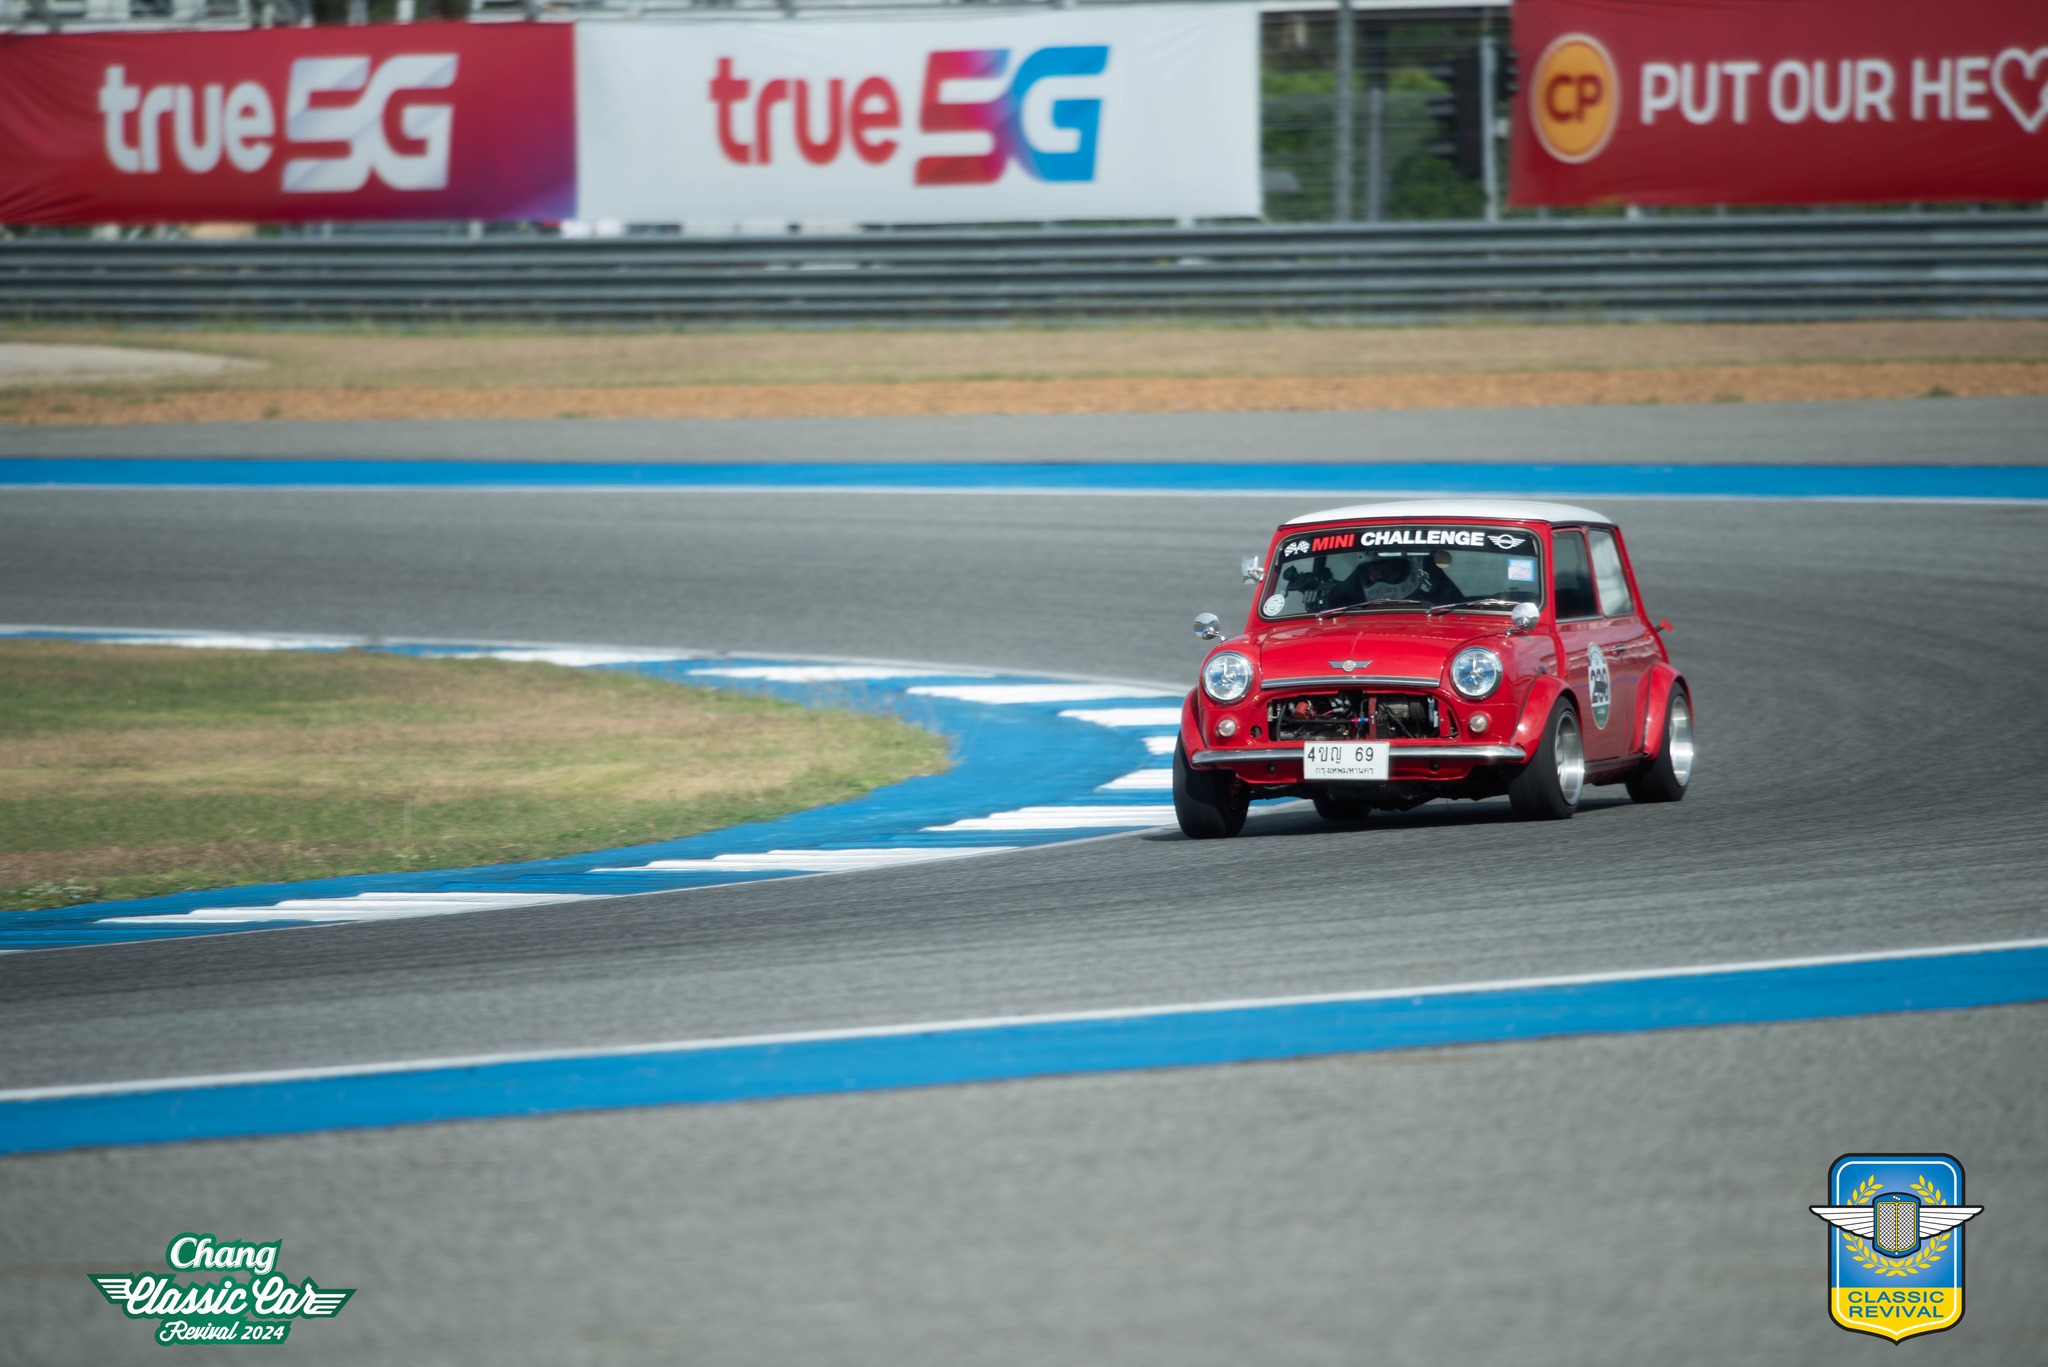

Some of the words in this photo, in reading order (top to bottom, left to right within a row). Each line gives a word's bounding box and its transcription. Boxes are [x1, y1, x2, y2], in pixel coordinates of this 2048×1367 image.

[708, 57, 901, 165] true
[913, 45, 1109, 186] 5G
[1545, 74, 1601, 124] CP
[1641, 61, 1760, 125] PUT
[1769, 59, 1894, 123] OUR
[98, 65, 275, 173] true
[281, 53, 459, 193] 5G
[1311, 534, 1355, 551] MINI
[1360, 531, 1485, 547] CHALLENGE
[1355, 747, 1374, 762] 69
